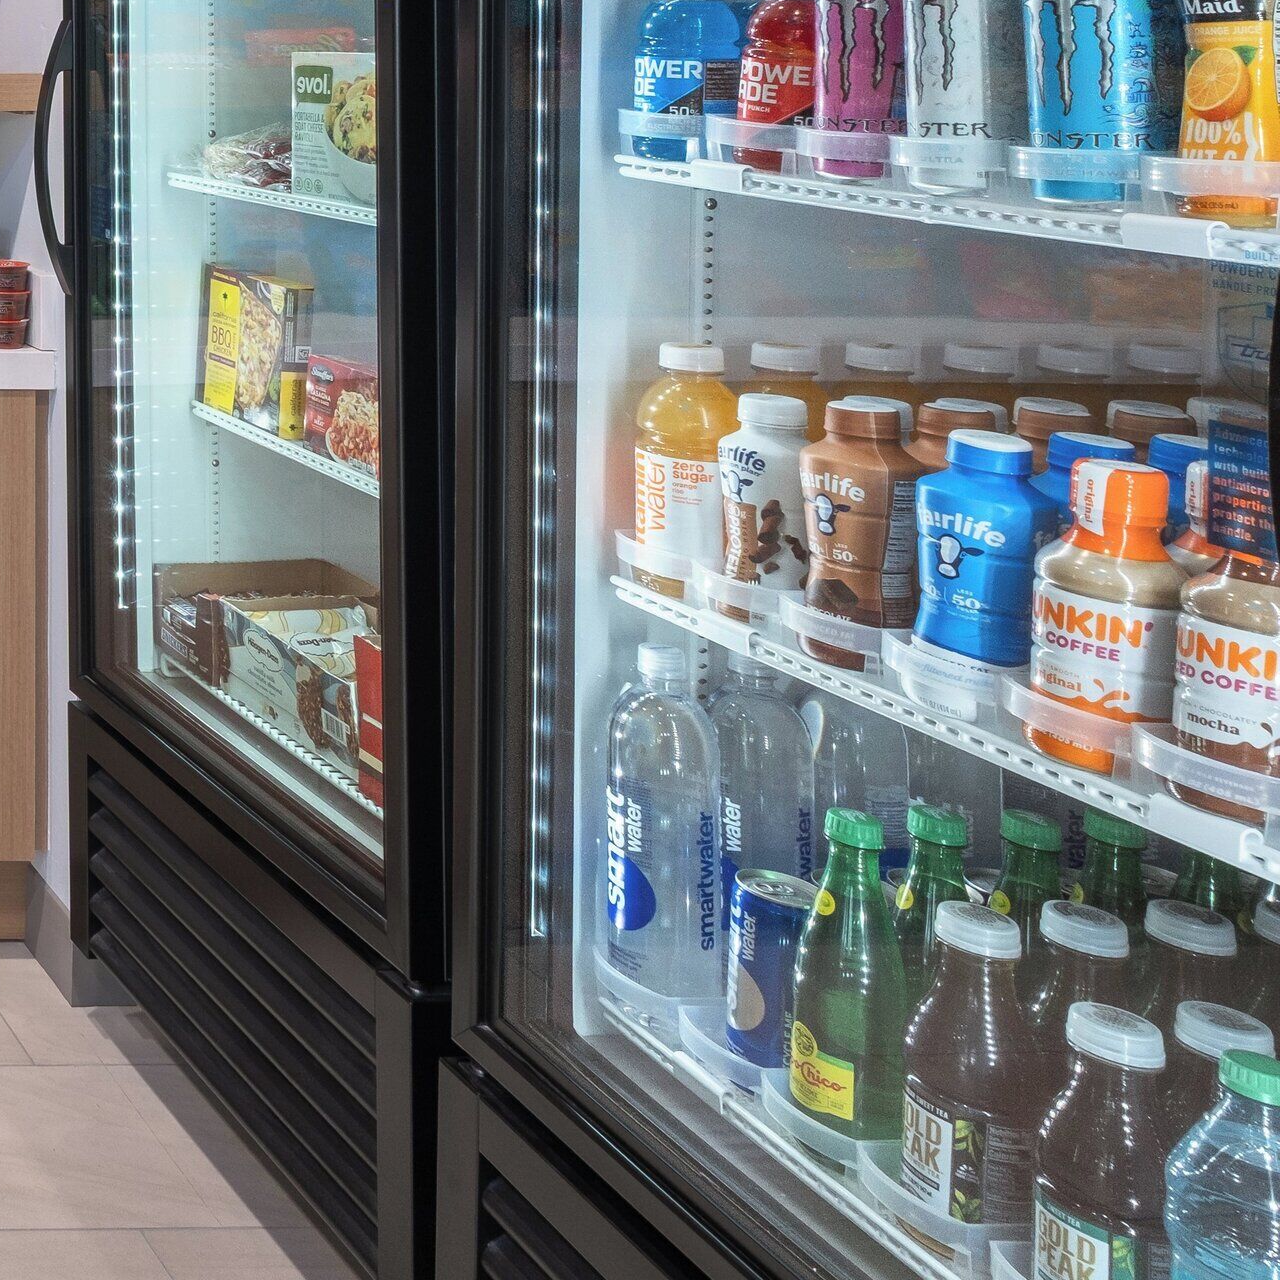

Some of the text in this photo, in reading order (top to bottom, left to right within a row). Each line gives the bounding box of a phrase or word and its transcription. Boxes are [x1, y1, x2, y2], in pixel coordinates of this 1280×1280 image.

[1194, 25, 1262, 35] ORANGE JUICE
[1185, 119, 1243, 145] 100%
[1210, 261, 1265, 279] POWDER
[1212, 280, 1253, 294] HANDLE
[211, 325, 232, 347] BBQ
[672, 460, 705, 473] zero
[672, 470, 714, 483] sugar
[1214, 461, 1270, 481] with built
[648, 456, 666, 531] water
[672, 482, 698, 490] orange
[1085, 478, 1095, 523] original
[1212, 491, 1273, 515] properties
[1212, 506, 1256, 527] protect
[1212, 524, 1255, 543] handle.
[1045, 629, 1121, 662] COFFEE
[1186, 710, 1240, 737] mocha
[627, 797, 642, 852] water
[726, 796, 742, 852] water
[606, 785, 625, 911] smart
[697, 811, 714, 952] smartwater
[742, 910, 758, 962] water
[1039, 1212, 1097, 1266] GOLD
